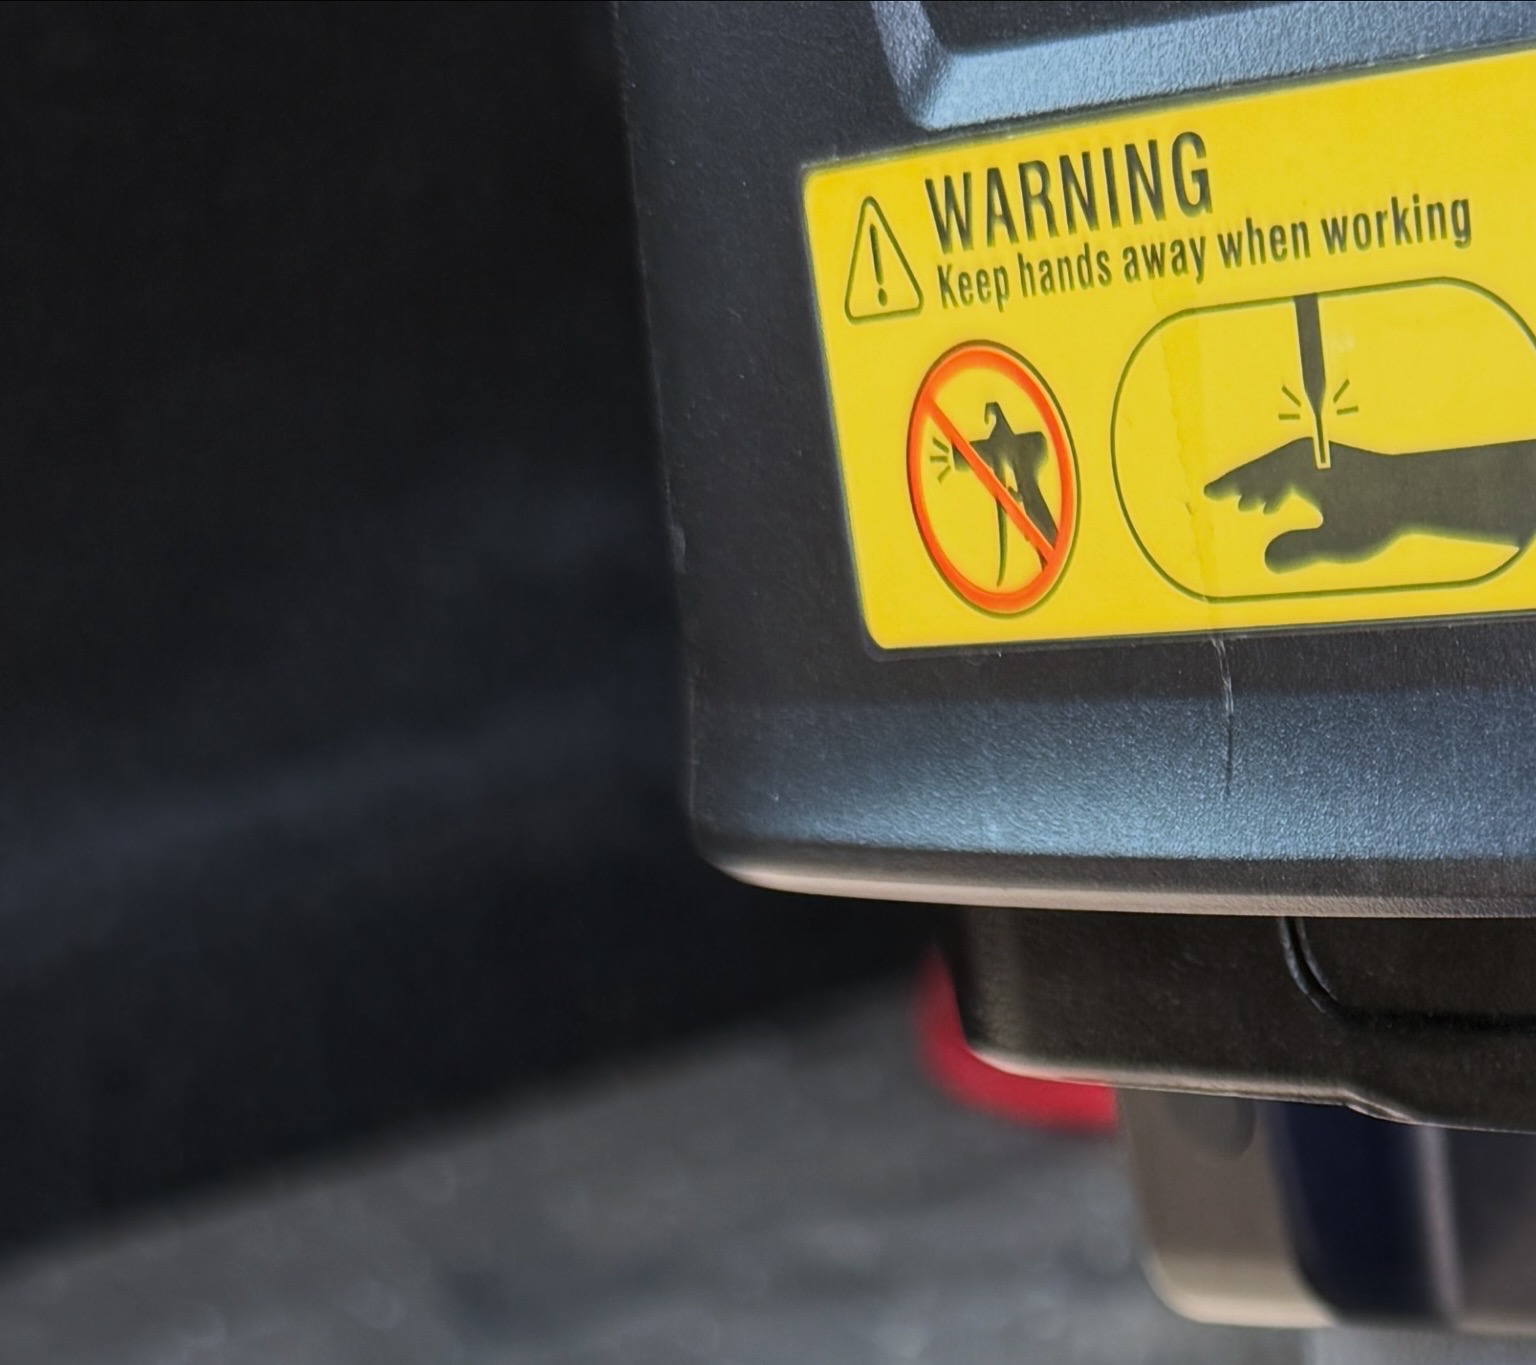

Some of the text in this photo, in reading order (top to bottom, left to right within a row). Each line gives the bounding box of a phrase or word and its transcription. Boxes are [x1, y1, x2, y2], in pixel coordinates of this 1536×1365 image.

[925, 131, 1213, 254] WARNING
[937, 193, 1472, 313] Keep hands away when working
